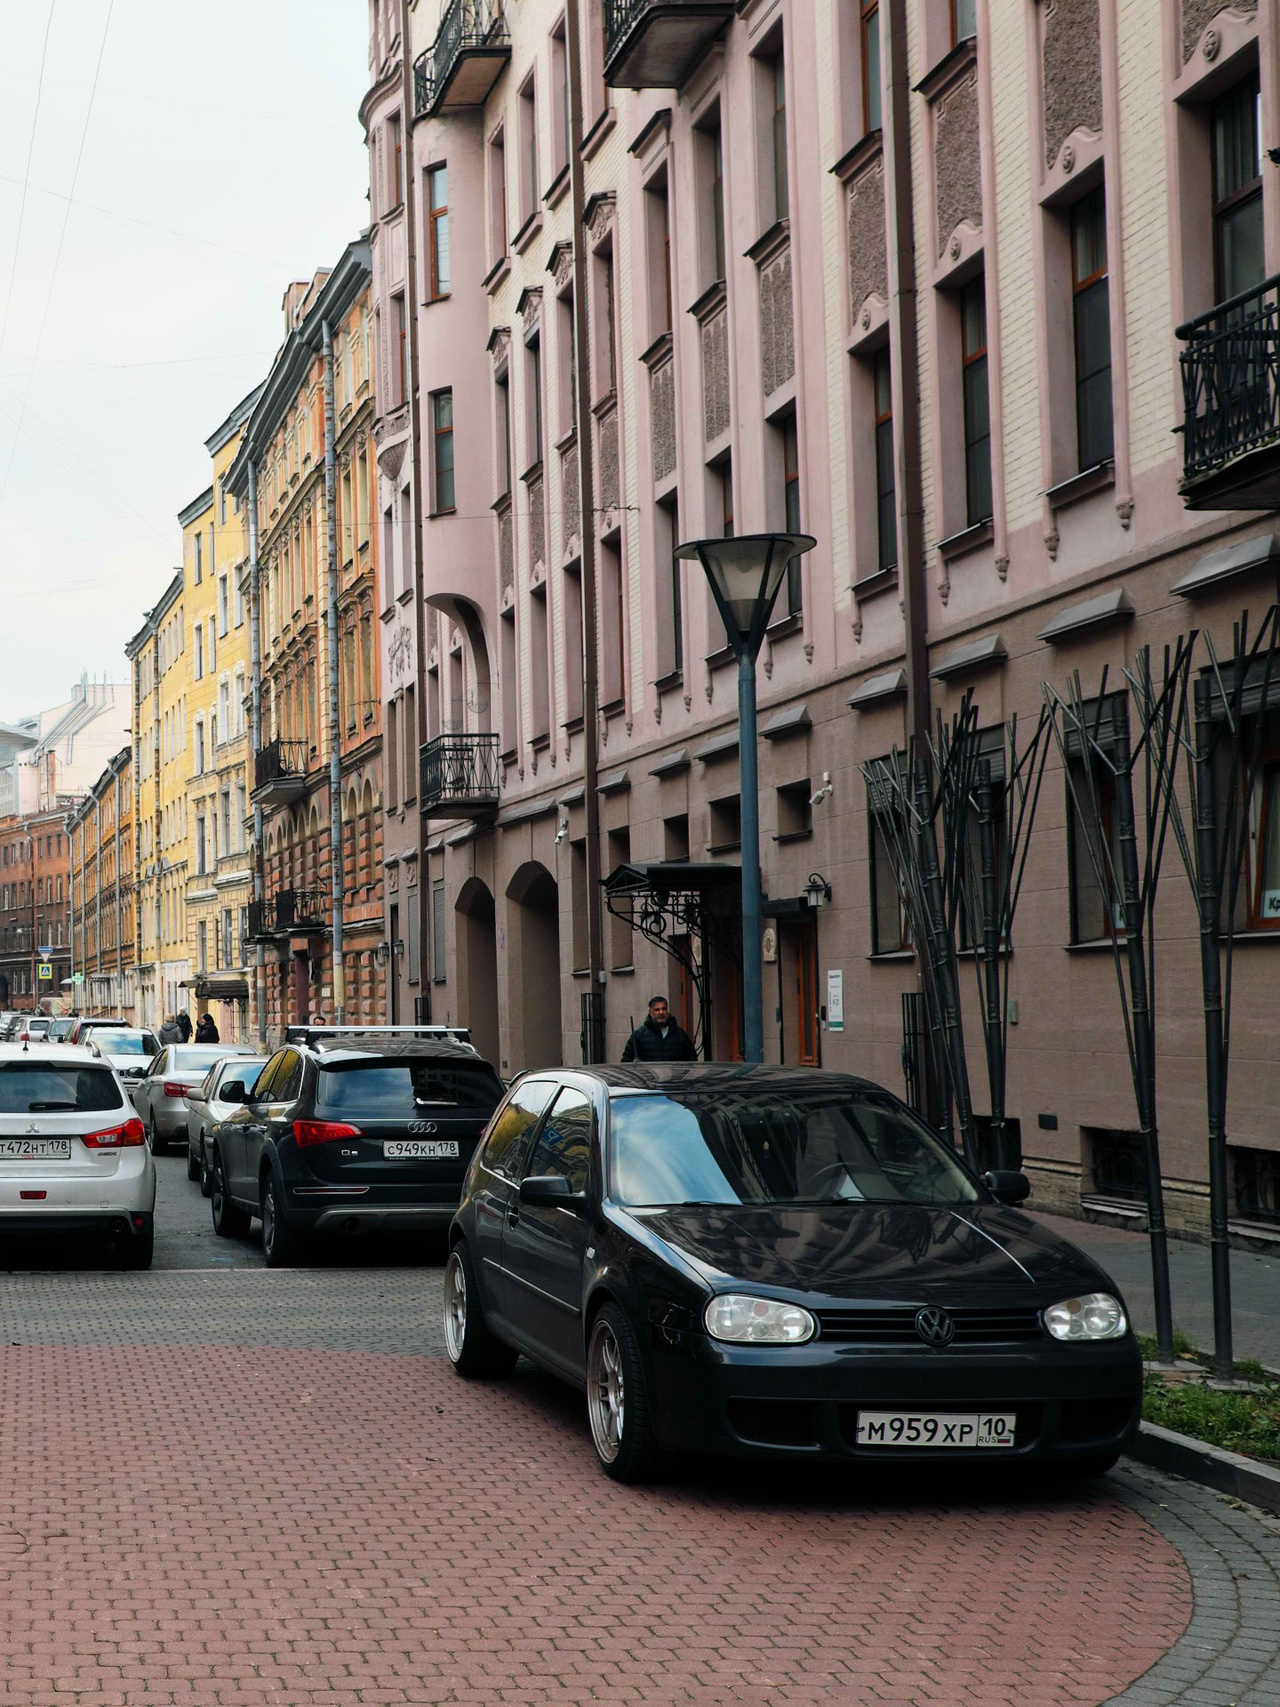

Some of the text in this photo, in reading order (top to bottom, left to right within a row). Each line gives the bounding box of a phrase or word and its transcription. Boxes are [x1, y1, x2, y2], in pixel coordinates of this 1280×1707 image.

[0, 1141, 67, 1154] Т472НТ 178
[387, 1142, 456, 1155] С949КН 178
[867, 1417, 1006, 1443] М959ХР 10
